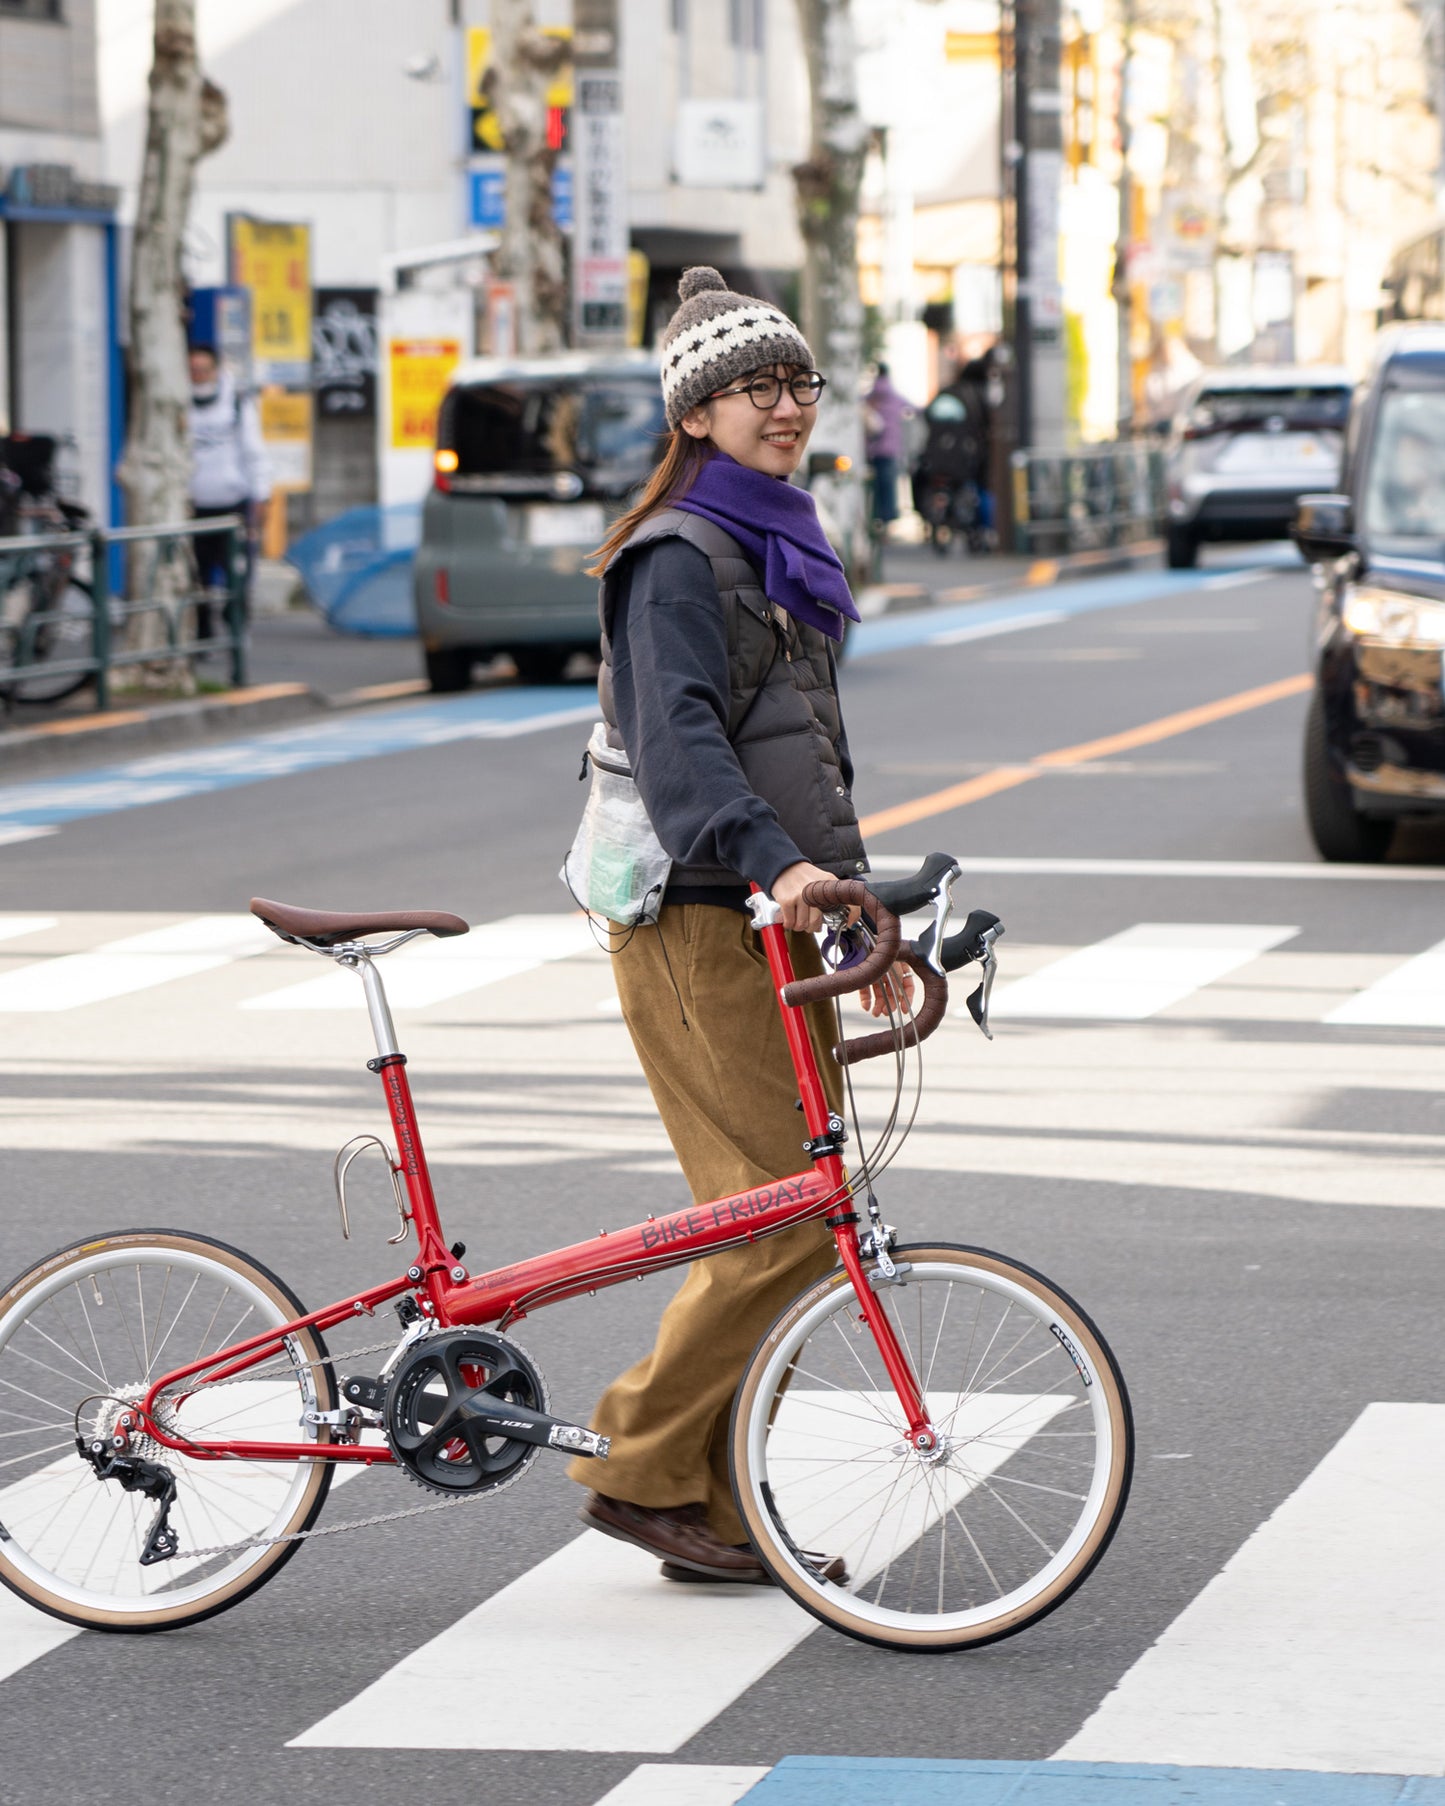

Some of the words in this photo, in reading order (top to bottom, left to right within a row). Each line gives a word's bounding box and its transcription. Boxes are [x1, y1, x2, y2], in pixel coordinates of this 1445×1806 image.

[388, 1074, 409, 1125] Rocket
[400, 1129, 420, 1176] Pocket
[640, 1211, 706, 1249] BIKE
[501, 1420, 535, 1429] 105
